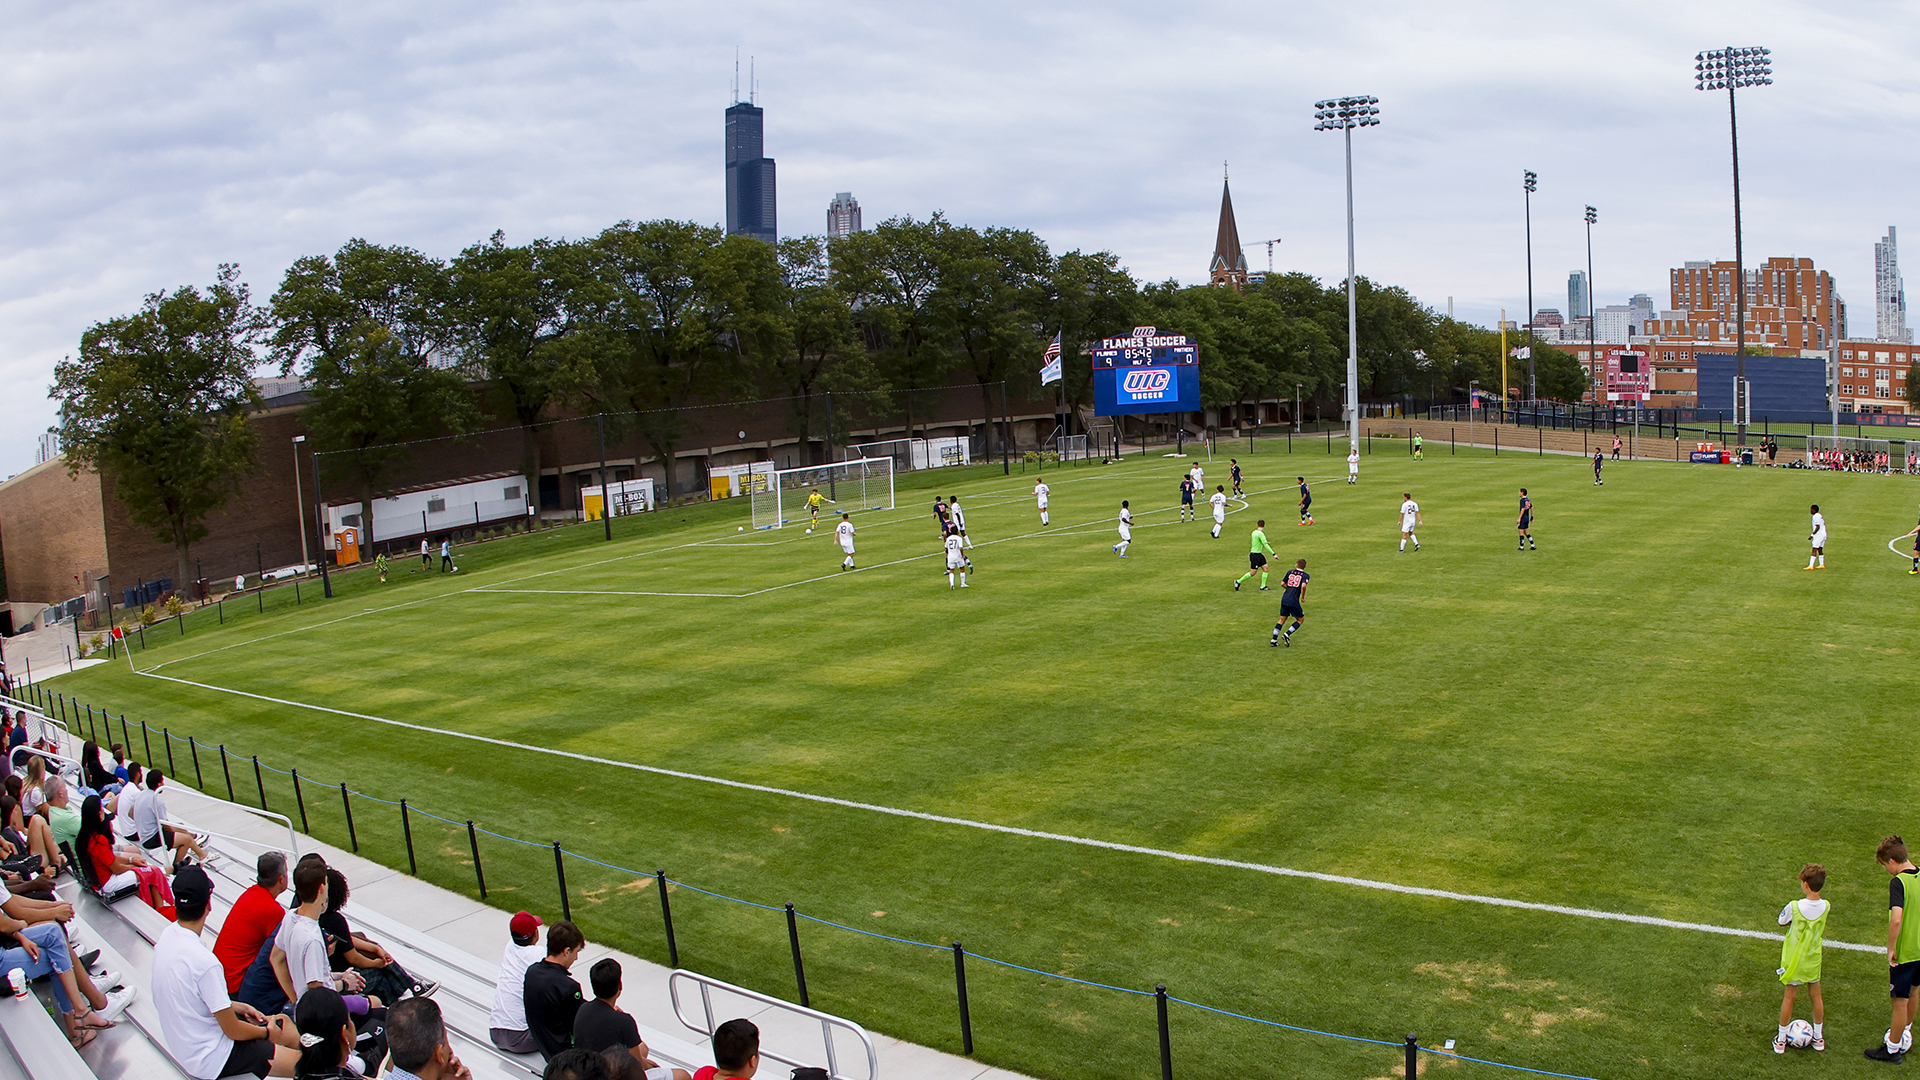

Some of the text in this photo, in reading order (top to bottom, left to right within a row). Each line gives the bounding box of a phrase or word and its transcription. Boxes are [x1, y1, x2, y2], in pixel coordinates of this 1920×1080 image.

[1133, 327, 1155, 337] UIC
[1103, 335, 1186, 349] FLAMES SOCCER
[1125, 348, 1152, 359] 85:42
[1186, 353, 1192, 363] 0
[1105, 357, 1112, 366] 9
[1147, 358, 1152, 366] 2
[1125, 371, 1169, 391] UIC
[1132, 392, 1163, 400] SOCCER
[948, 539, 957, 549] 27
[1288, 574, 1302, 587] 29
